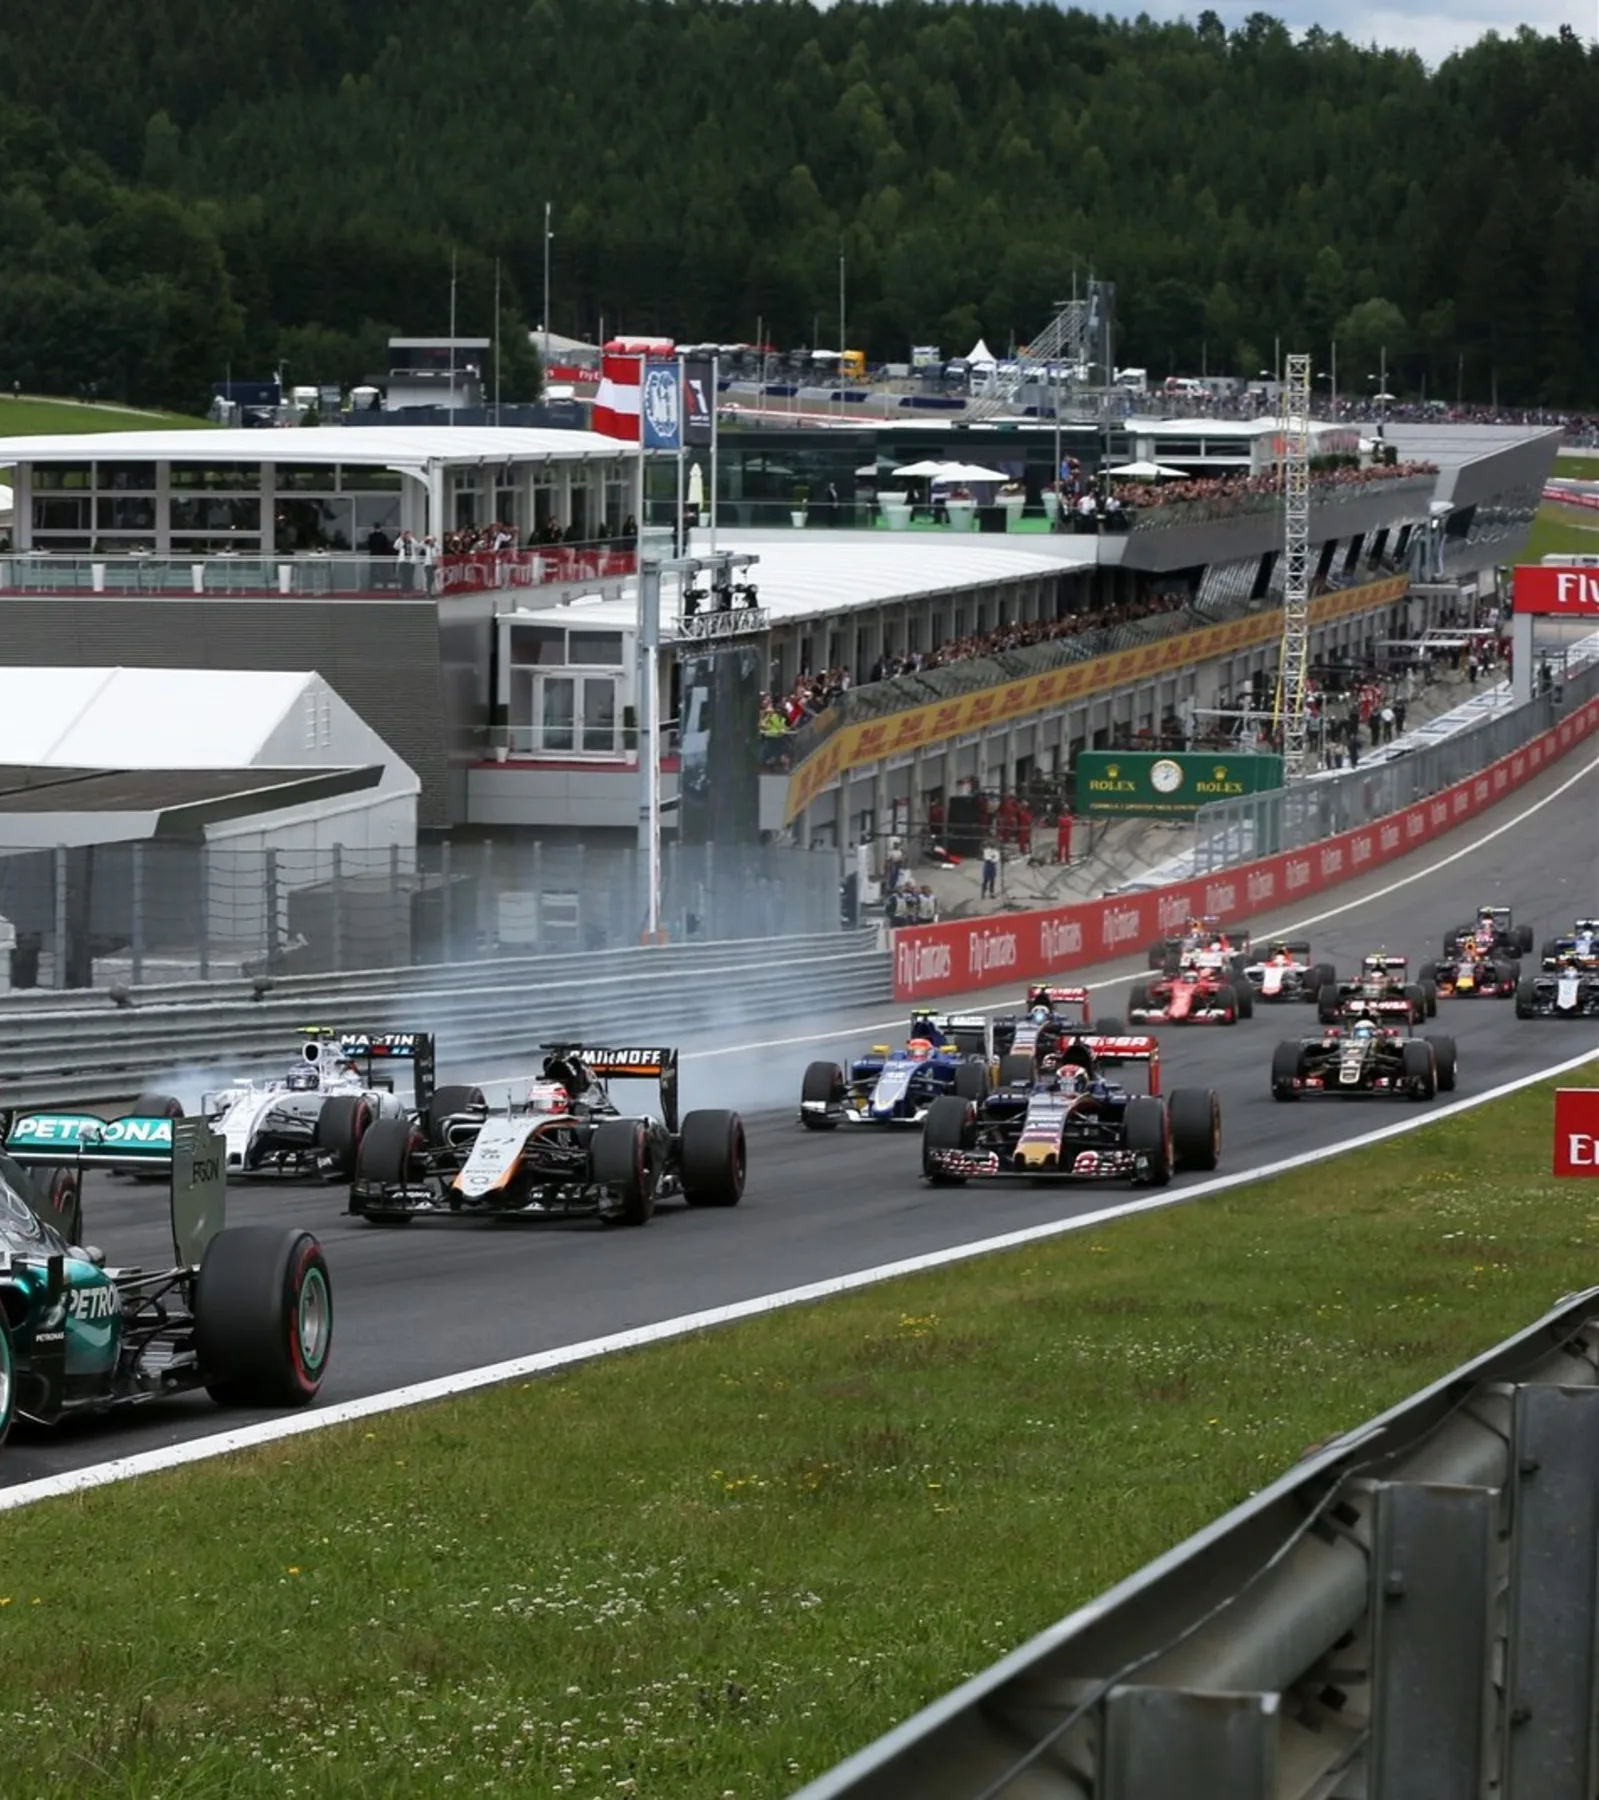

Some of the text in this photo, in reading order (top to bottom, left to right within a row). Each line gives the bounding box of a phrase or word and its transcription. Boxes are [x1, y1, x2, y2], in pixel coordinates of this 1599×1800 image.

[1090, 780, 1136, 791] ROLEX
[1196, 782, 1243, 793] ROLEX
[898, 936, 951, 992] Fly Emirates
[969, 926, 1016, 980] Fly Emirates
